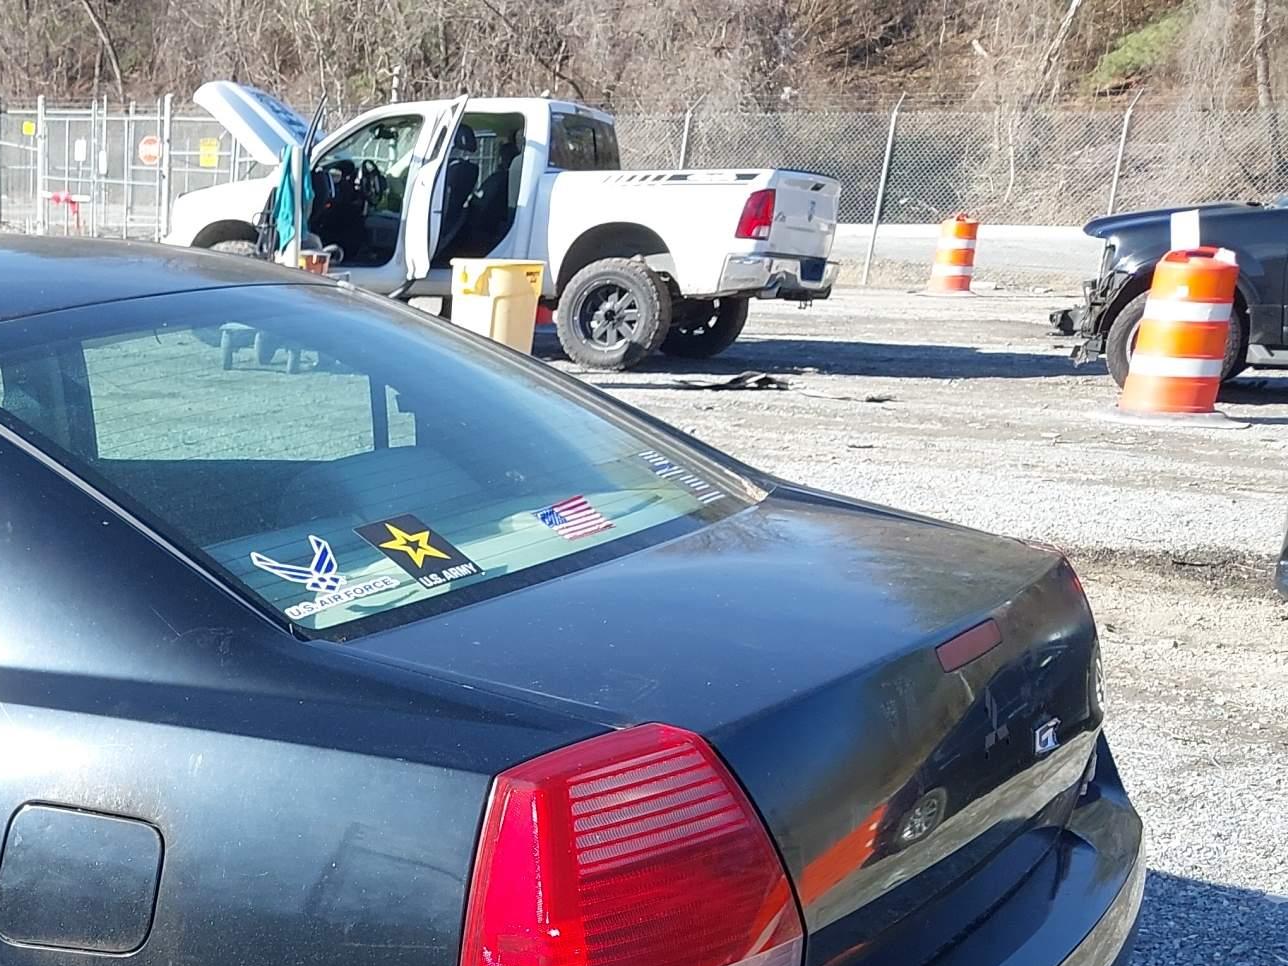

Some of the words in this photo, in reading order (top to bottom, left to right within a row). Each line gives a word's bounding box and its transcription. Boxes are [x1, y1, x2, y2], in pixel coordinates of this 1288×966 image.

[419, 573, 445, 588] U.S.
[444, 563, 478, 583] ARMY
[289, 604, 318, 618] U.S.
[319, 593, 344, 609] AIR
[345, 578, 395, 600] FORCE
